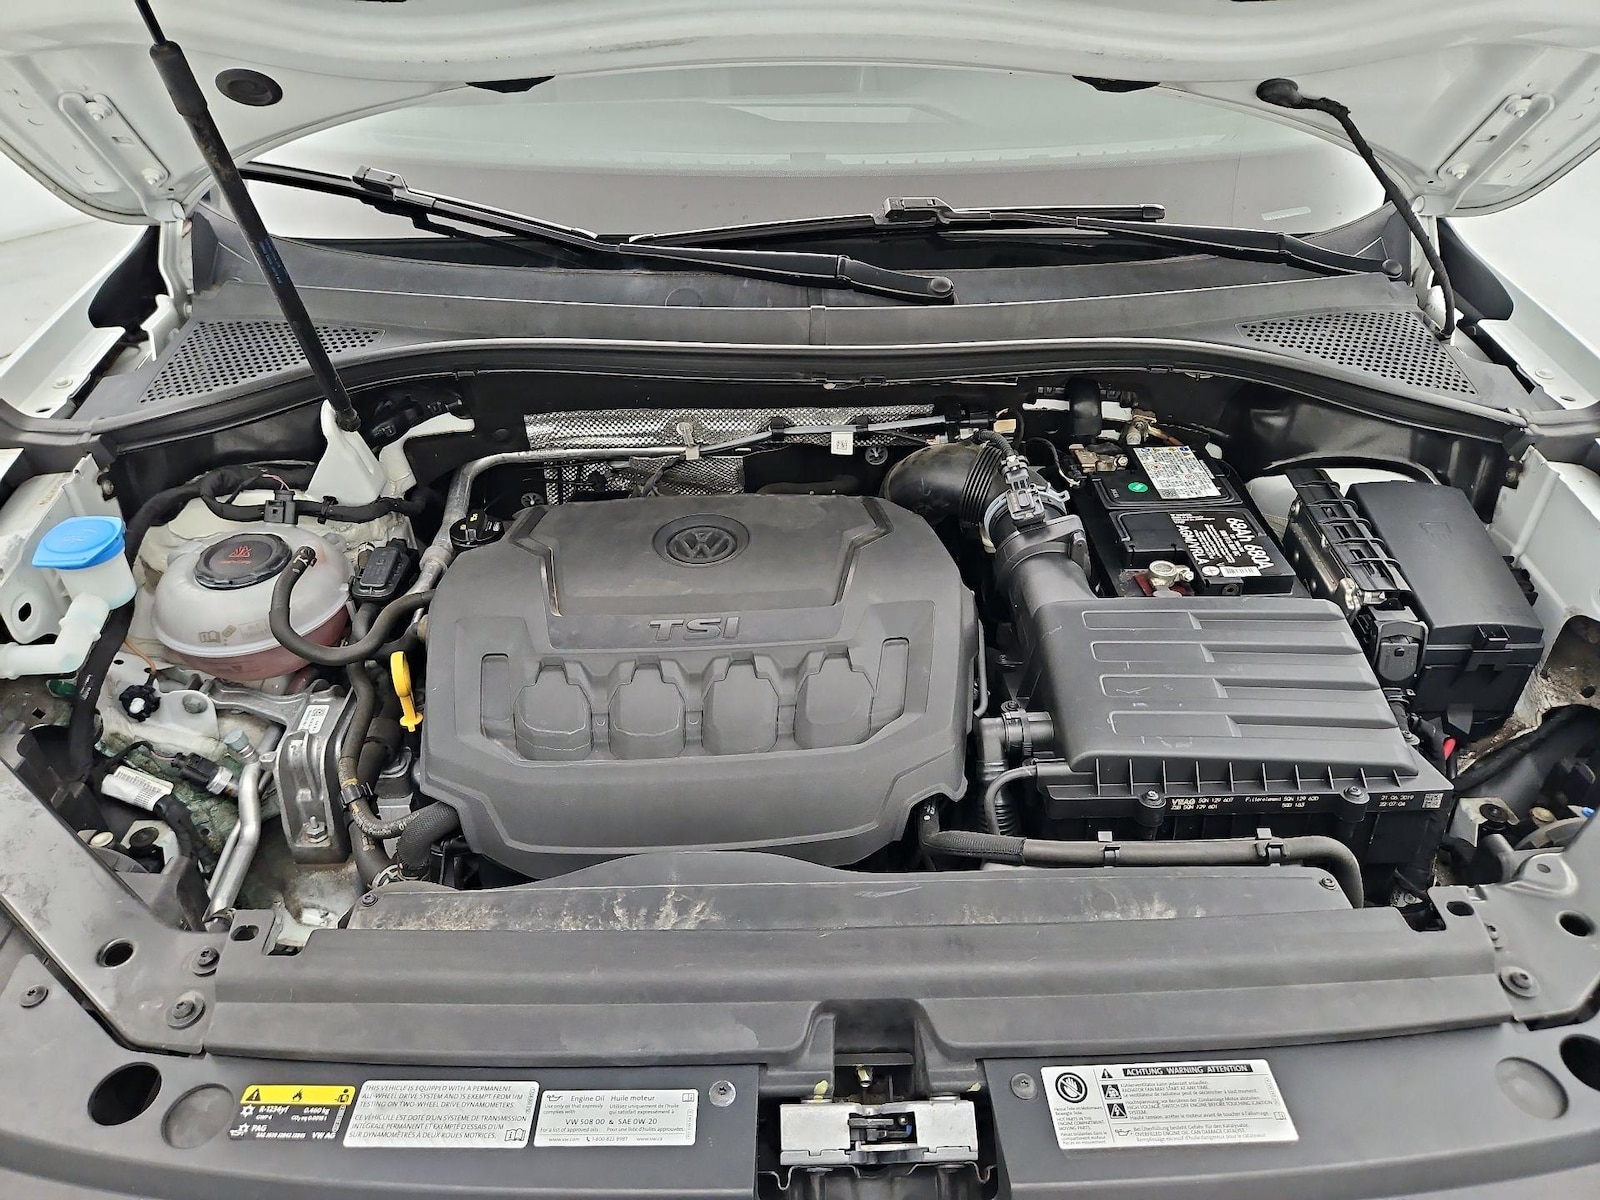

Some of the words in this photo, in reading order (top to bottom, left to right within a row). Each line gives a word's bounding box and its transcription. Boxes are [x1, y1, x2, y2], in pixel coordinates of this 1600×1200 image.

[1176, 524, 1210, 565] AGM/VRLA
[1226, 518, 1256, 542] 68Ah
[1243, 544, 1275, 569] 680A
[649, 616, 740, 641] TSI
[1126, 1067, 1163, 1076] ACHTUNG
[1166, 1065, 1203, 1074] WARNING
[1207, 1064, 1248, 1073] ATTENTION
[570, 1095, 594, 1103] Engine
[258, 1106, 290, 1115] R-1234yf
